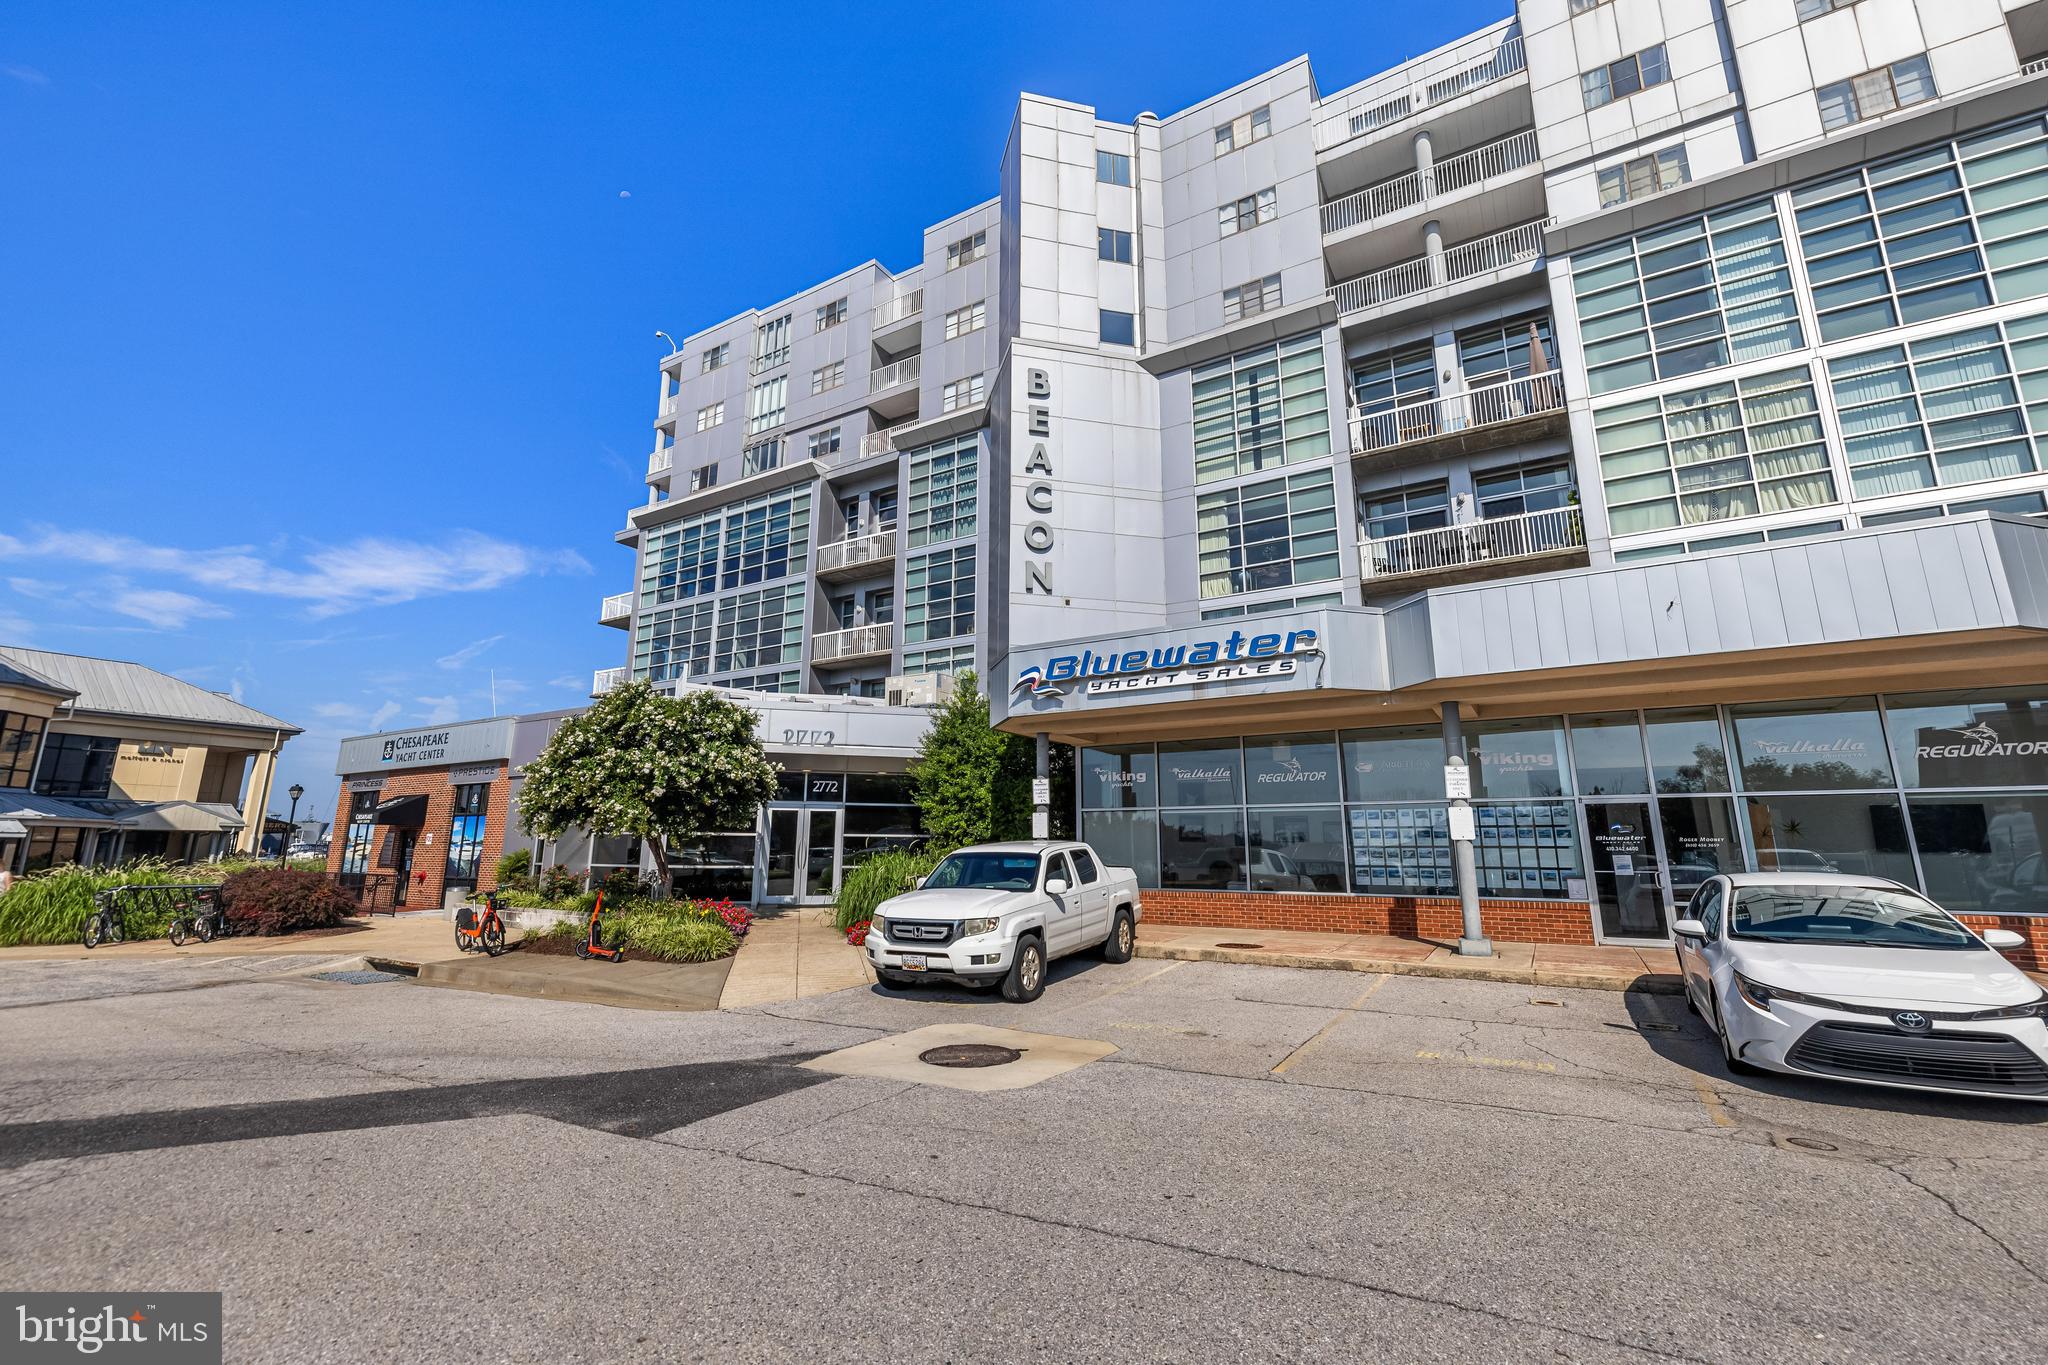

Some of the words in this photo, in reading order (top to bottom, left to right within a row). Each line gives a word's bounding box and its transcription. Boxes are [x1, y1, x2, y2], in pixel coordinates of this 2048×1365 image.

[1025, 367, 1054, 595] BEACON
[1045, 629, 1318, 682] Bluewater
[1090, 674, 1178, 691] YACHT
[1196, 661, 1294, 681] SALES
[783, 729, 835, 747] 2772
[1765, 738, 1866, 754] valhalla
[1916, 741, 2048, 759] REGULATOR
[395, 751, 416, 763] YACHT
[418, 749, 445, 760] CENTER
[1480, 752, 1553, 766] viking
[458, 766, 496, 776] PRESTIGE
[1100, 771, 1147, 783] viking
[1178, 767, 1231, 779] valhalla
[1257, 771, 1327, 783] REGULATOR
[352, 779, 383, 789] PRINCESS
[813, 781, 838, 793] 2772
